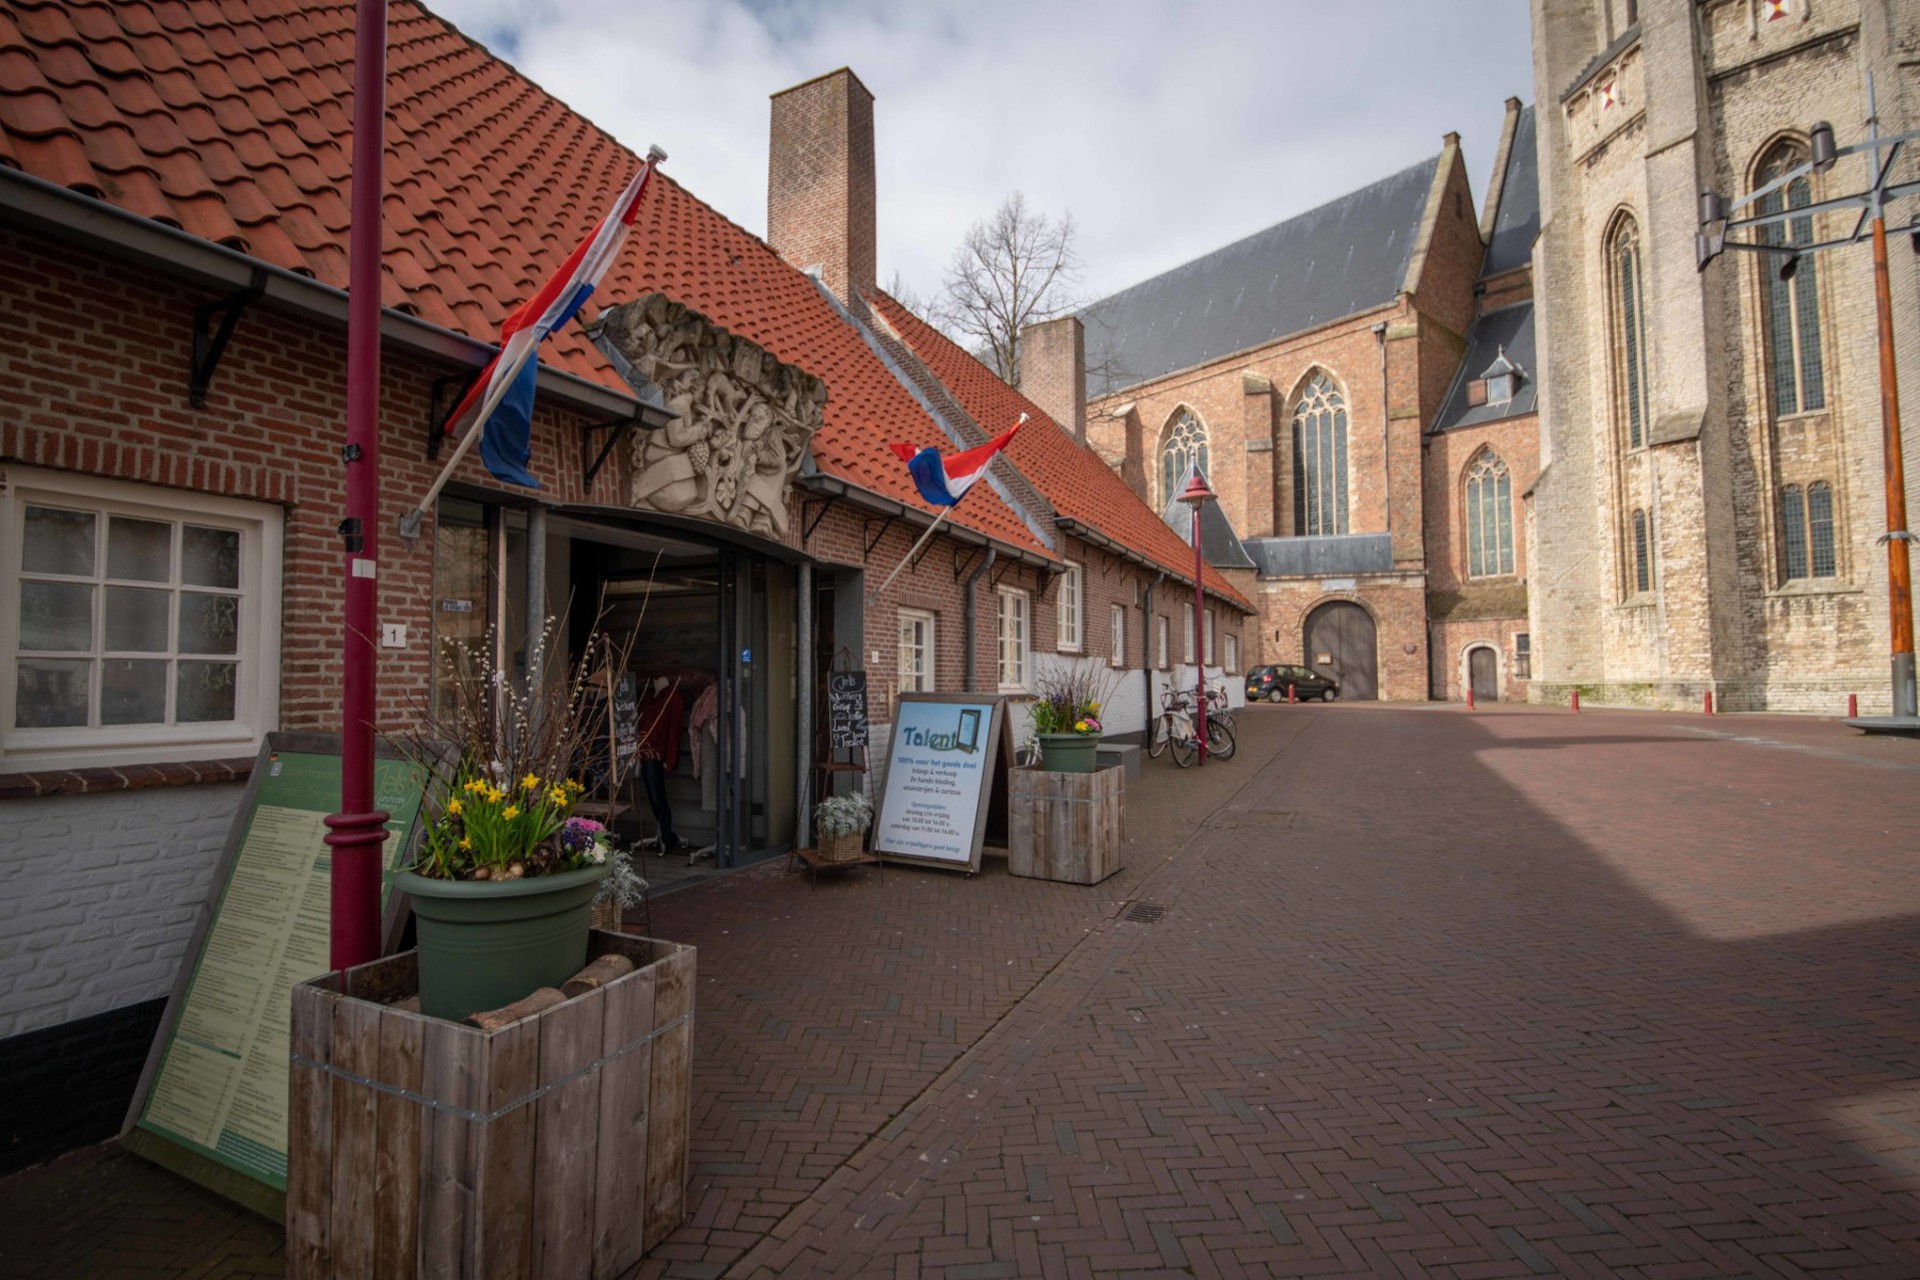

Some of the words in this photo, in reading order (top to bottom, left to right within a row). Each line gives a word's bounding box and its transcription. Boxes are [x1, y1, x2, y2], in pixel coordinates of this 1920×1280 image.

[390, 628, 397, 642] 1
[903, 726, 957, 748] Talent
[897, 756, 914, 764] 100%
[930, 758, 941, 766] het
[962, 761, 977, 769] doel
[918, 776, 934, 784] hands
